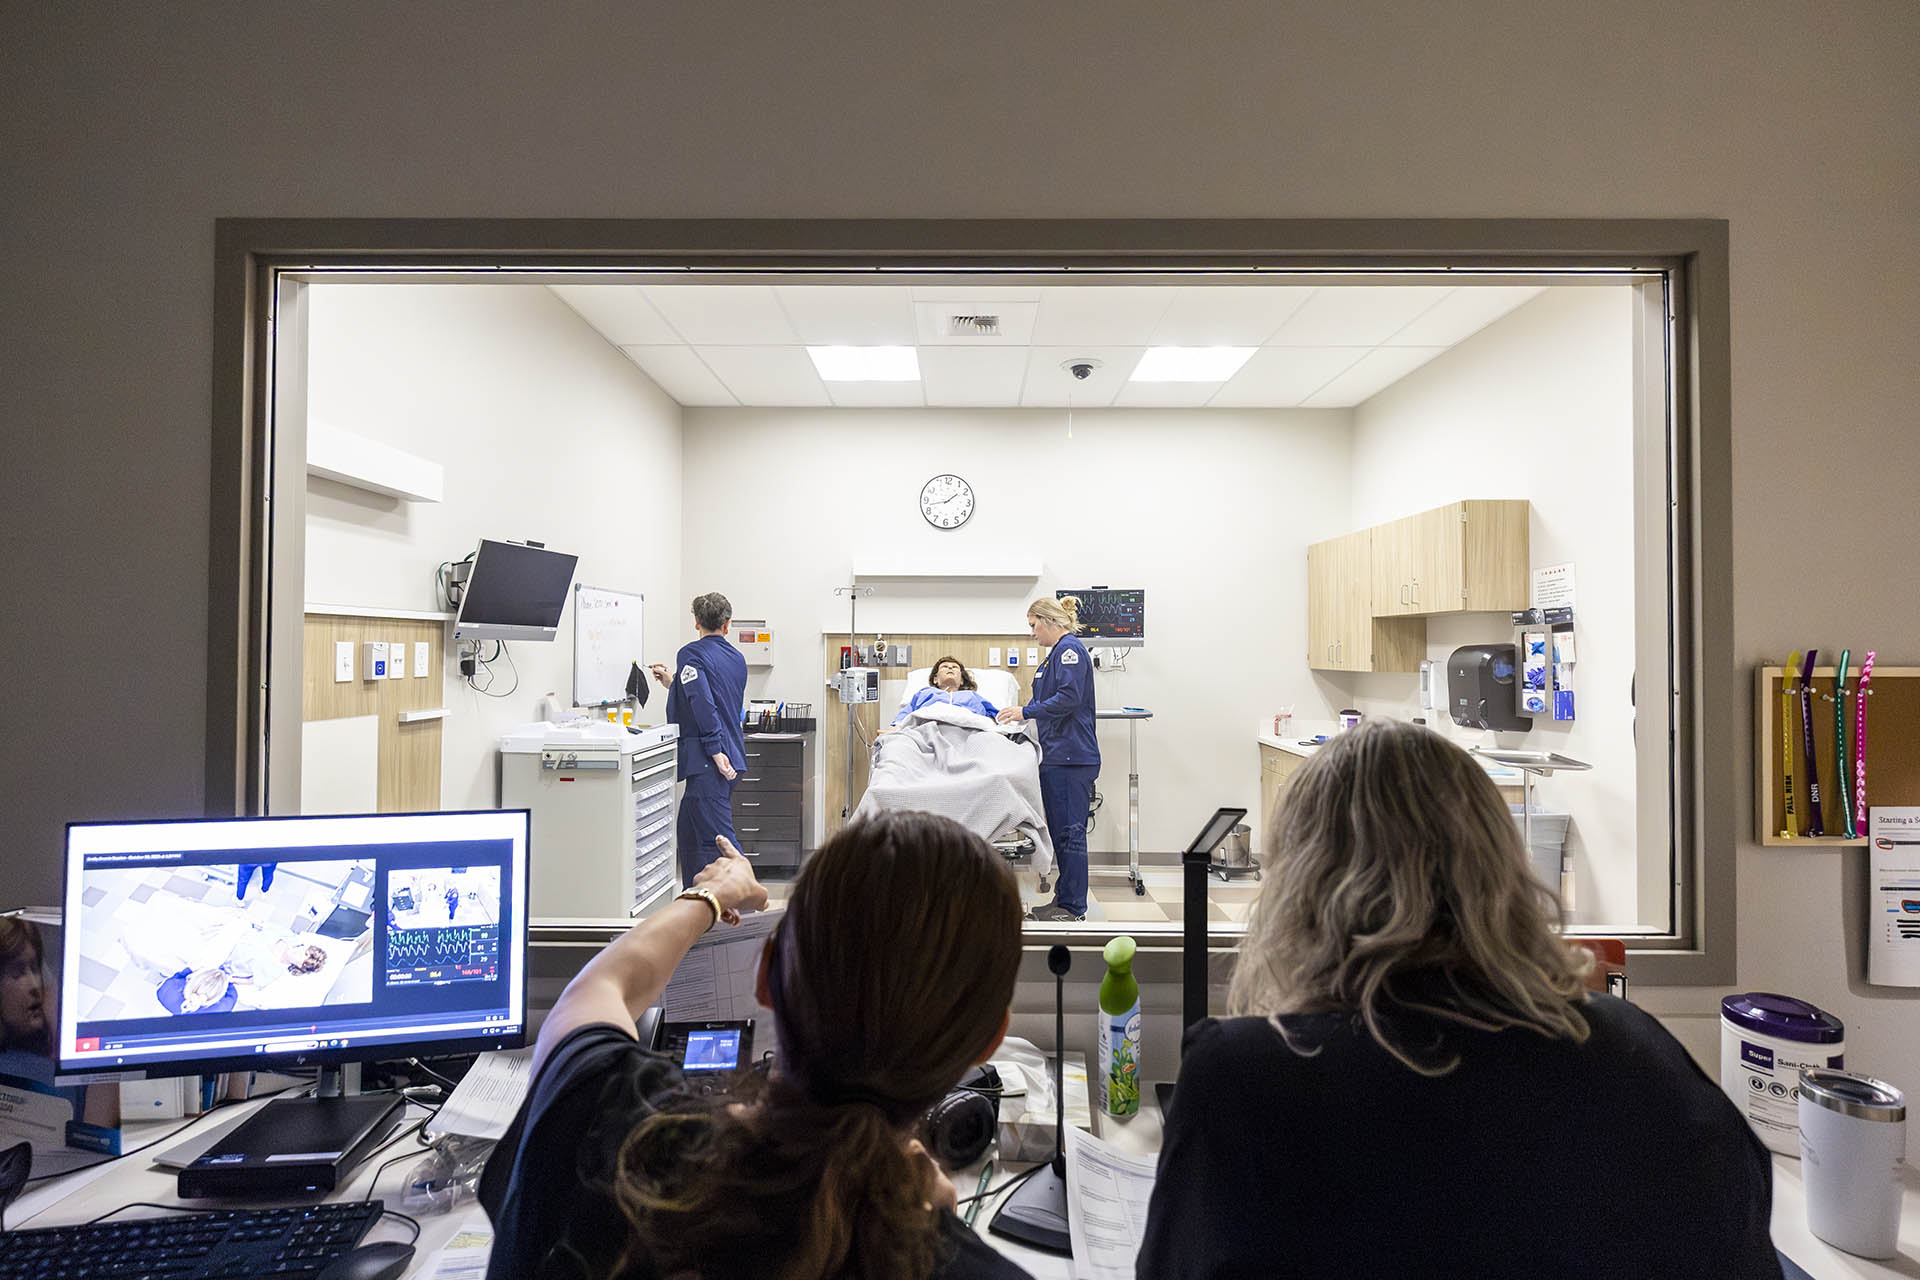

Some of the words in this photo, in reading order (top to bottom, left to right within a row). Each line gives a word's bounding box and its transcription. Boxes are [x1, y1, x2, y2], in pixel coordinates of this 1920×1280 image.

[945, 477, 952, 485] 12
[966, 499, 971, 507] 3
[926, 507, 931, 515] 8
[954, 516, 959, 524] 5
[1811, 783, 1820, 802] DNR
[1878, 816, 1906, 824] Starting
[1748, 1050, 1772, 1062] Super
